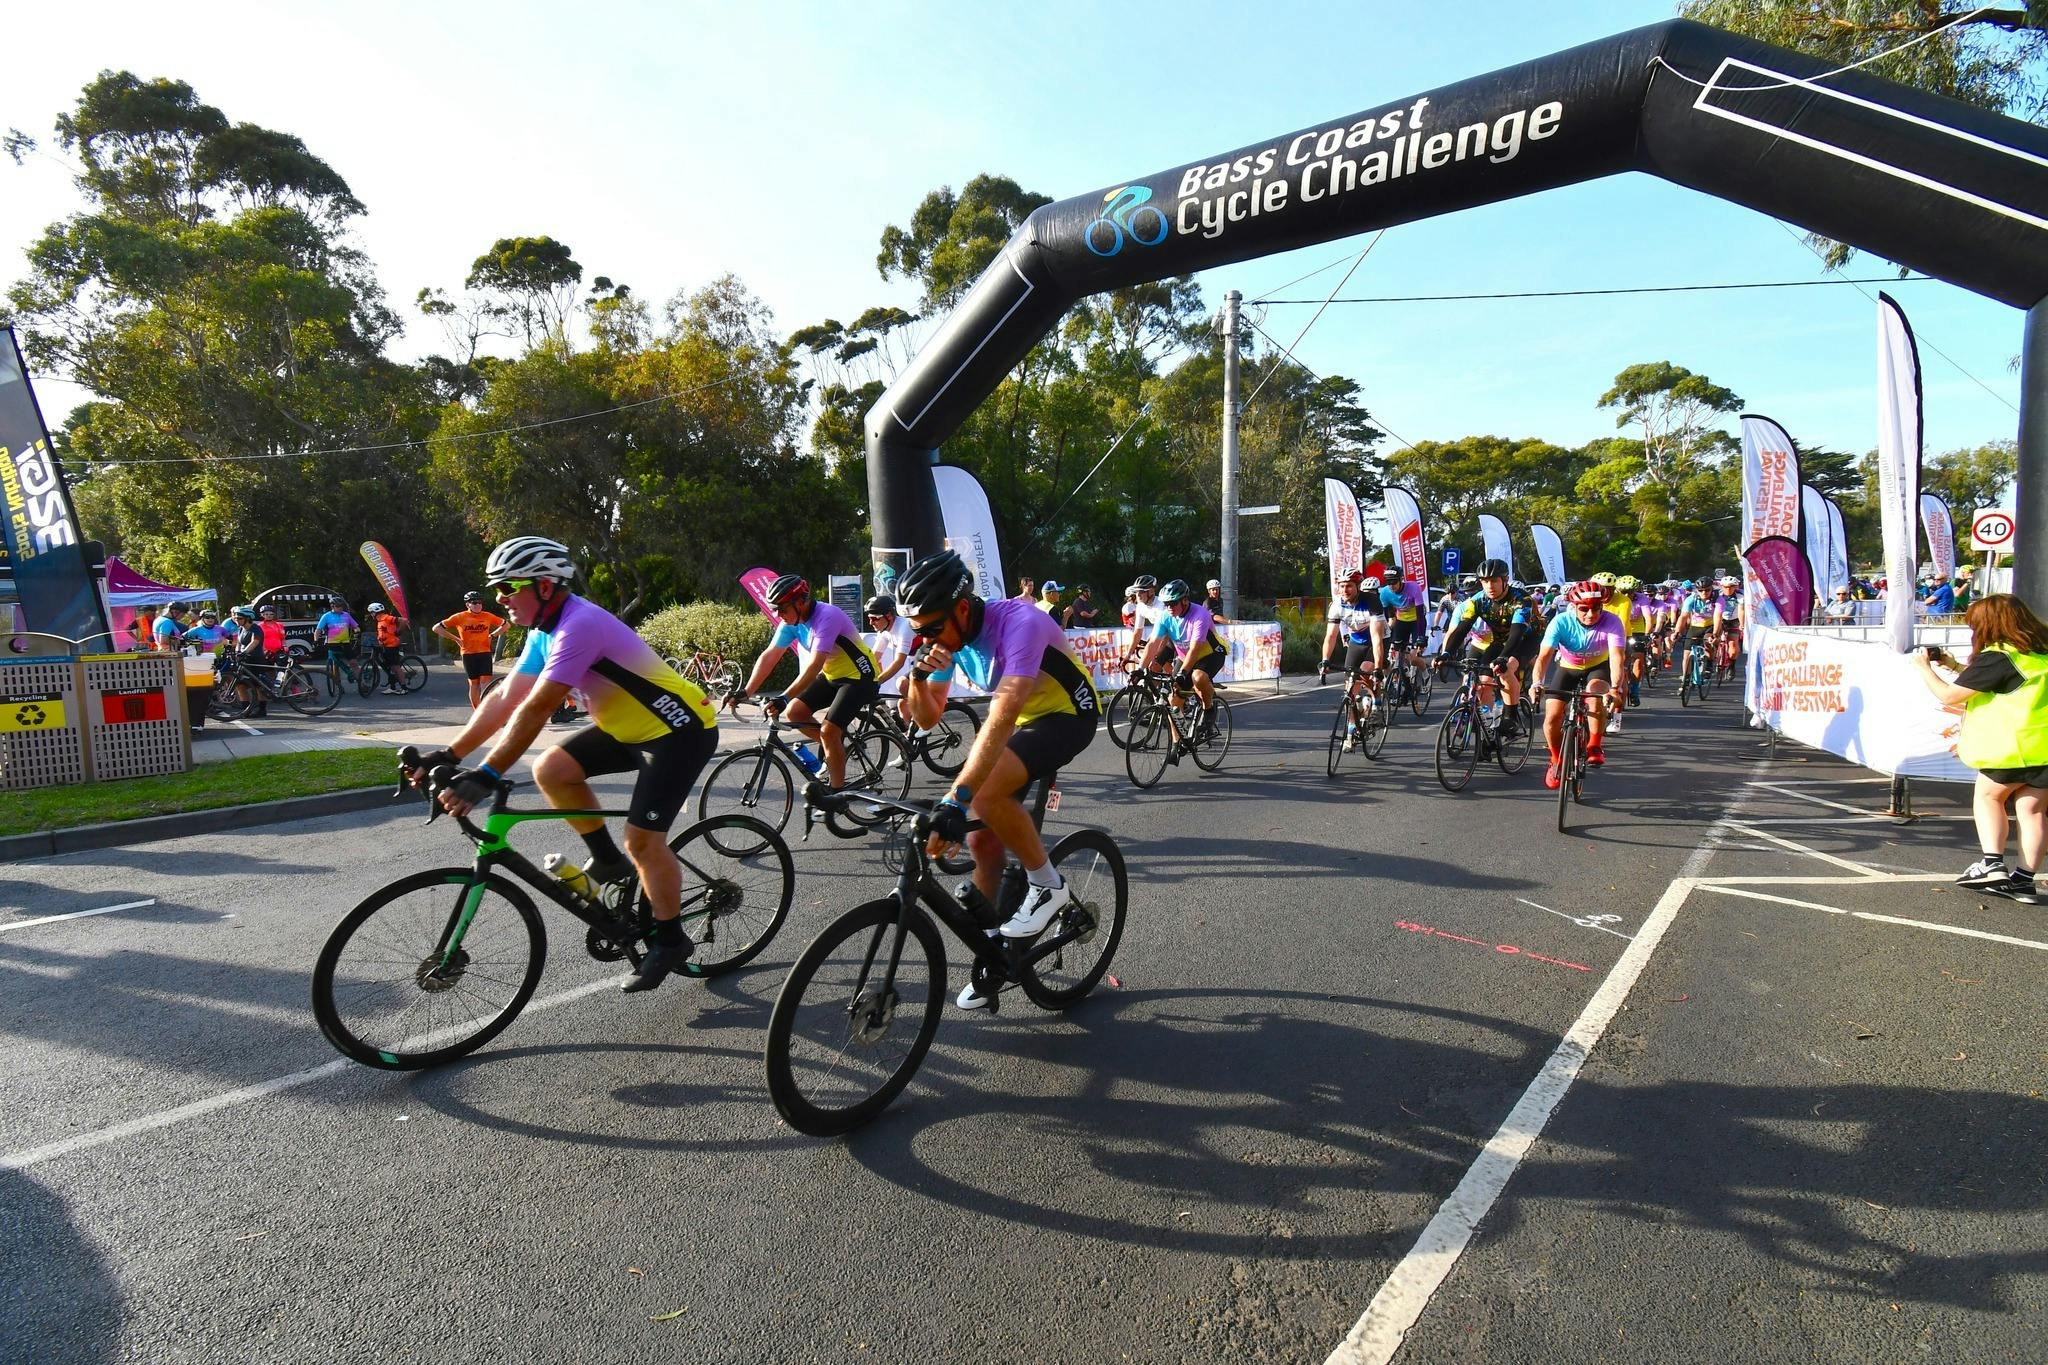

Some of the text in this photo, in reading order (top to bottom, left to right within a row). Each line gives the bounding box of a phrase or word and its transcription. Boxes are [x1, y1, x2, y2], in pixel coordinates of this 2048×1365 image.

[1177, 96, 1432, 200] Bass Coast
[1176, 100, 1564, 239] Cycle Challenge
[1979, 522, 2007, 537] 40
[1446, 551, 1457, 564] P
[375, 561, 400, 592] COFFEE
[1775, 641, 1809, 665] COAST
[1776, 664, 1843, 688] CHALLENGE
[9, 694, 48, 702] Recycling
[1793, 690, 1846, 713] FESTIVAL
[651, 694, 691, 728] BCCC
